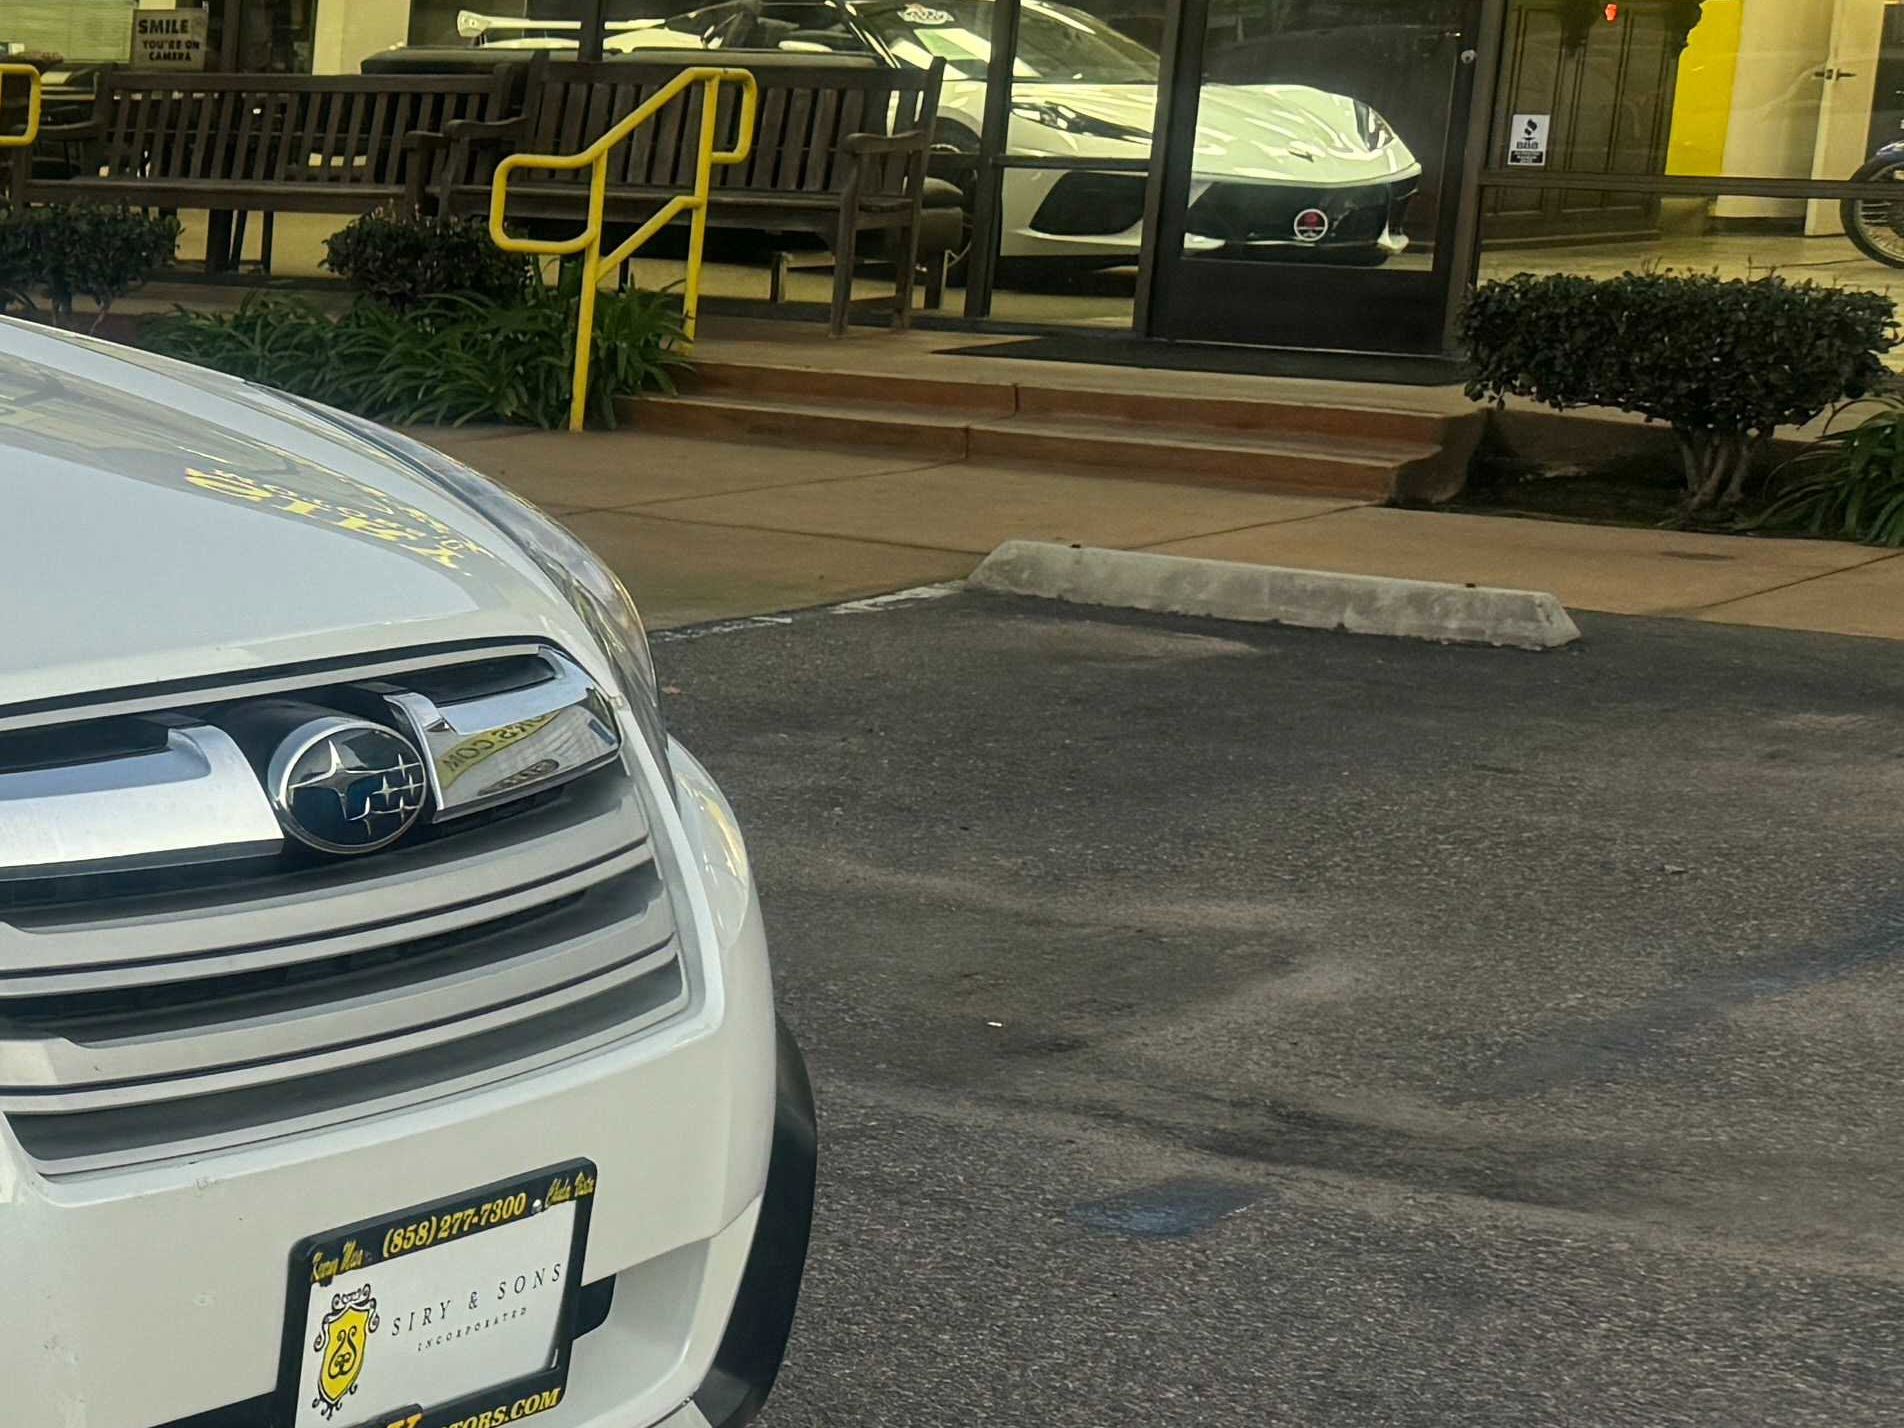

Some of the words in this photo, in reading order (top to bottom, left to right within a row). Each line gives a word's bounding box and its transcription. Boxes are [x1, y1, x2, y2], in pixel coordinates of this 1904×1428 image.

[138, 19, 189, 34] SMILE
[392, 1299, 452, 1336] SIRY
[468, 1291, 480, 1310] &
[497, 1263, 562, 1301] SONS
[417, 1306, 528, 1352] INCORPORATED
